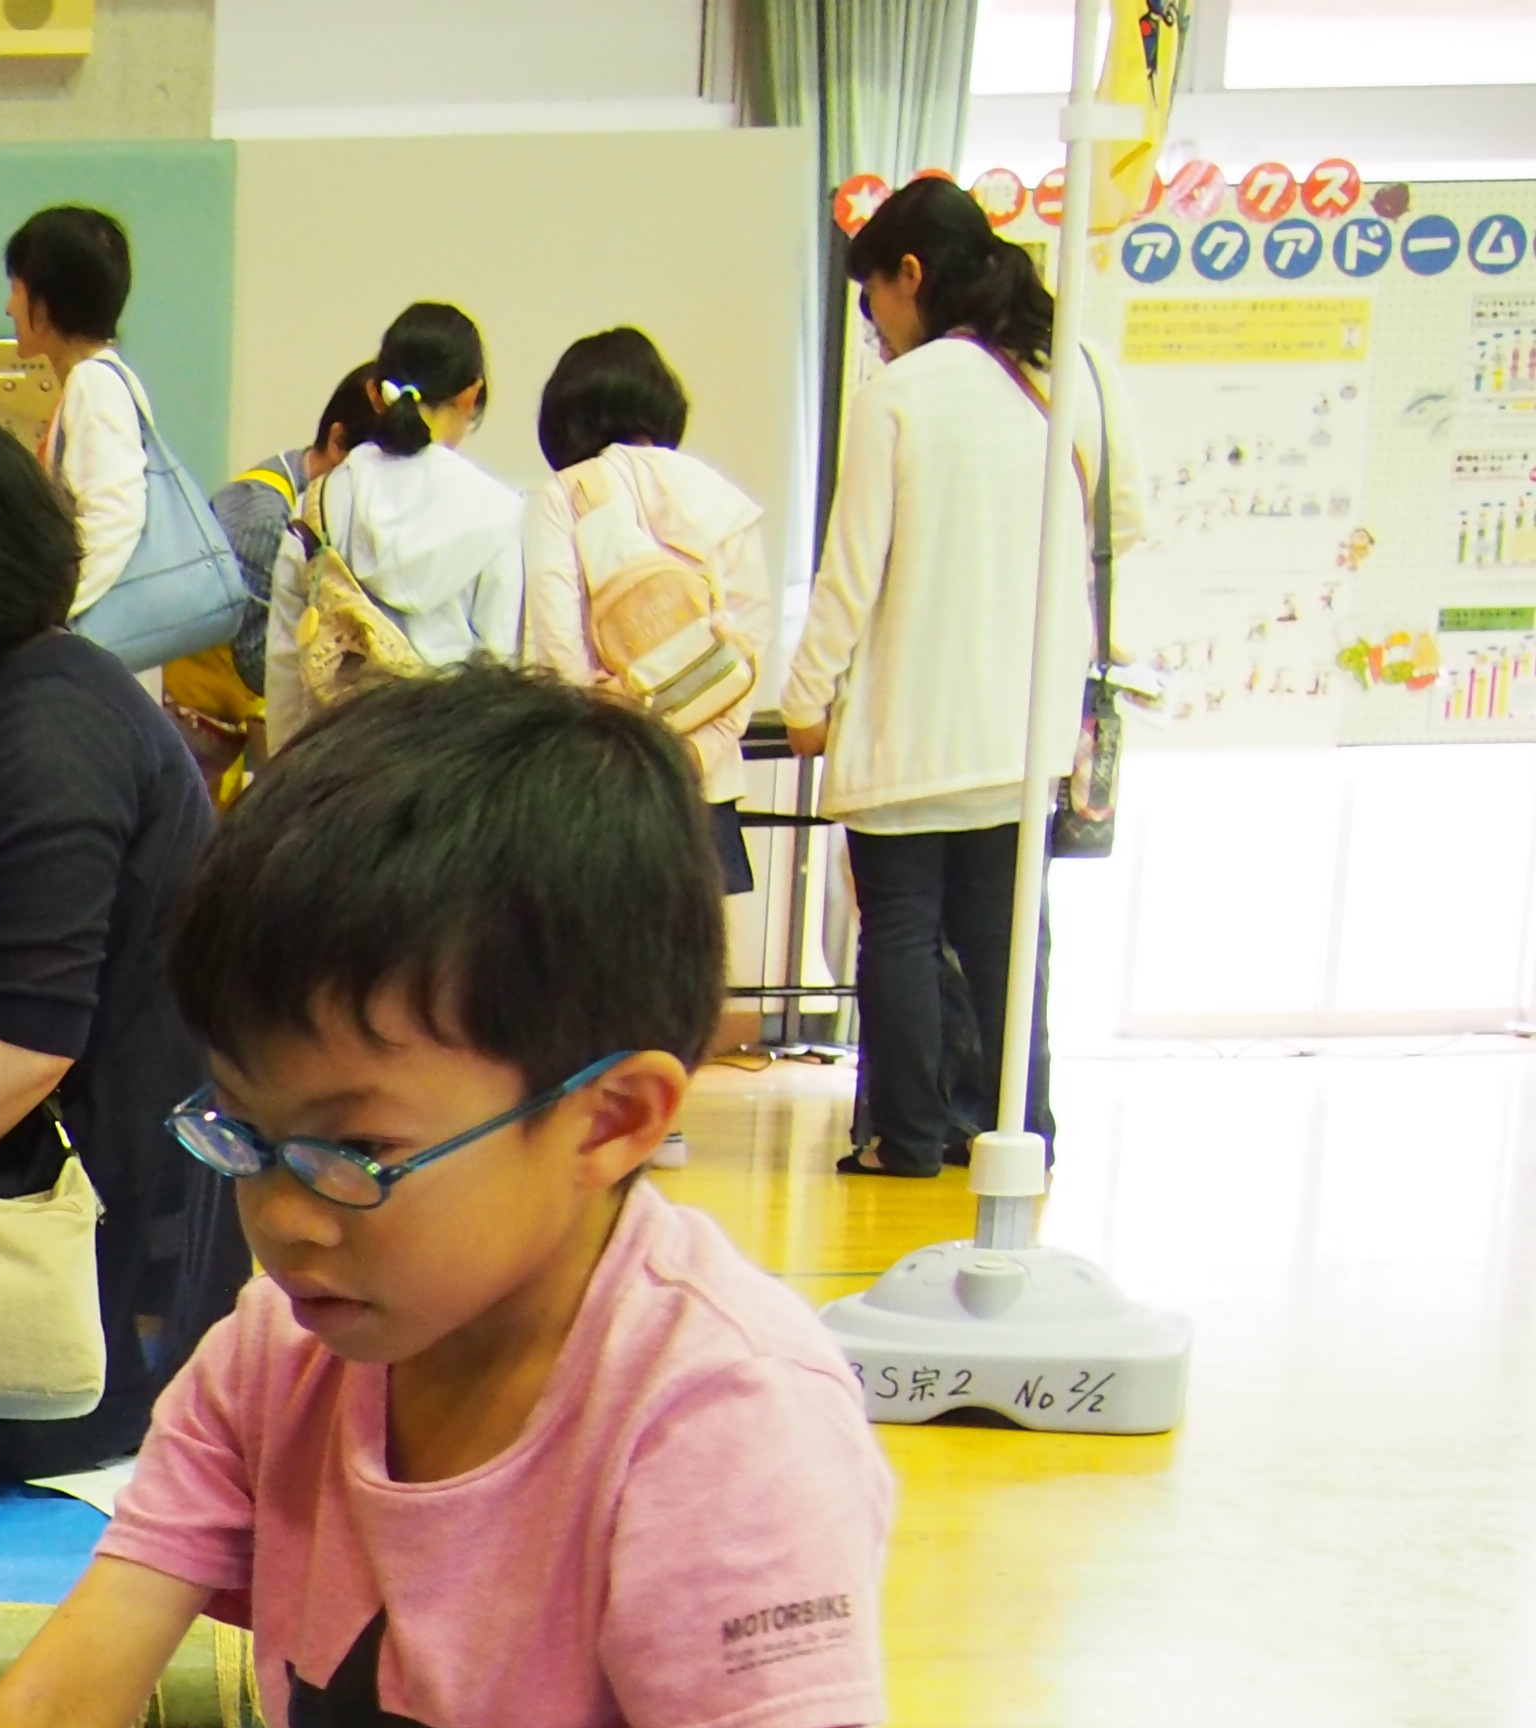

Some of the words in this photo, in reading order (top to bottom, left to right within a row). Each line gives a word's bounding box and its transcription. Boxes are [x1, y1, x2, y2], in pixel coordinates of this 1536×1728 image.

[1130, 219, 1517, 274] アクアドーム
